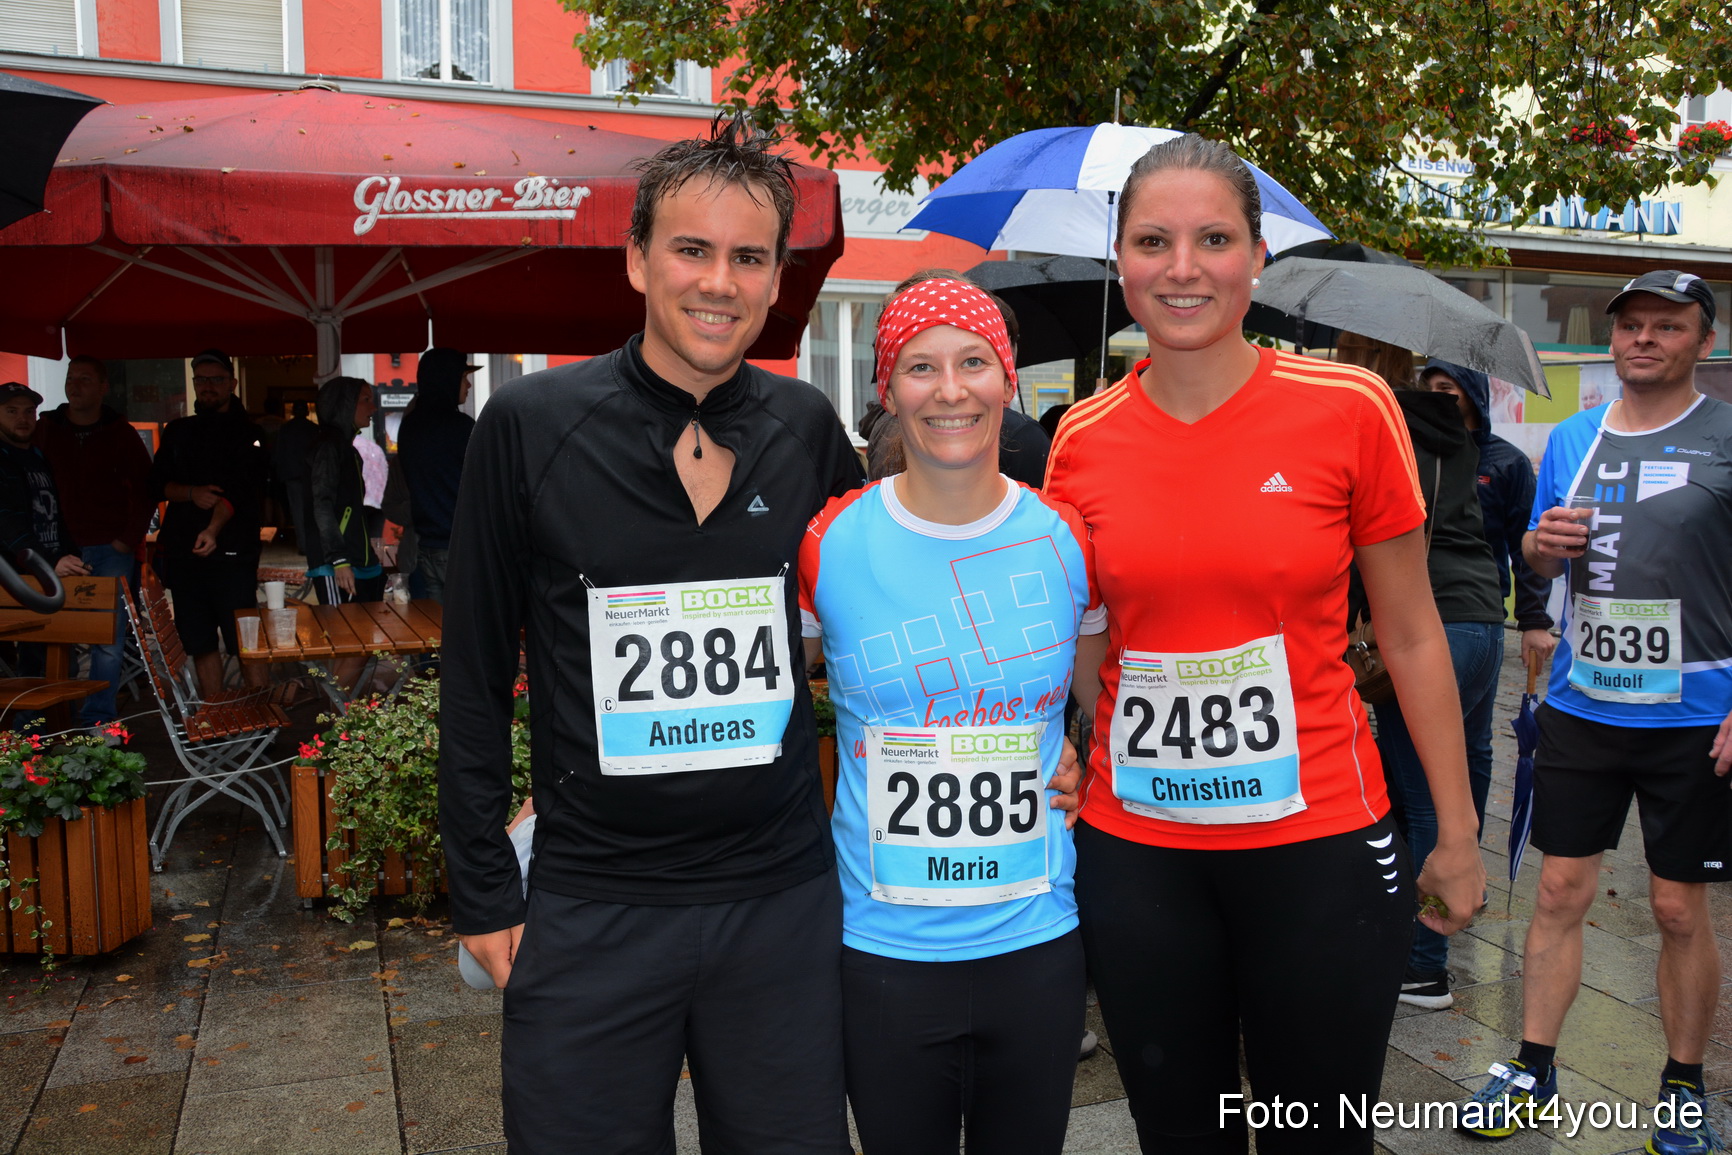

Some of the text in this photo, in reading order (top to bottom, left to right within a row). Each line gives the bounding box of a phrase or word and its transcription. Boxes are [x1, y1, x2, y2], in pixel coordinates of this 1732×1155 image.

[353, 176, 591, 236] Glossner-Bier
[841, 197, 911, 226] erger
[1260, 484, 1293, 493] adidas
[681, 585, 774, 612] BOCK
[1609, 603, 1669, 616] BOCK
[605, 606, 670, 620] NeuerMarkt
[682, 607, 776, 620] inspired by smart concepts
[1580, 620, 1670, 665] 2639
[615, 625, 781, 702] 2884
[1176, 646, 1271, 679] BOCK
[1180, 679, 1208, 687] inspired
[1240, 668, 1273, 678] concepts
[1593, 670, 1643, 689] Rudolf
[649, 718, 756, 747] Andreas
[1123, 685, 1280, 760] 2483
[881, 747, 939, 759] NeuerMarkt
[951, 731, 1039, 755] BOCK
[951, 756, 980, 764] inspired
[981, 756, 990, 764] by
[1152, 775, 1263, 802] Christina
[887, 769, 1038, 838] 2885
[927, 856, 999, 881] Maria
